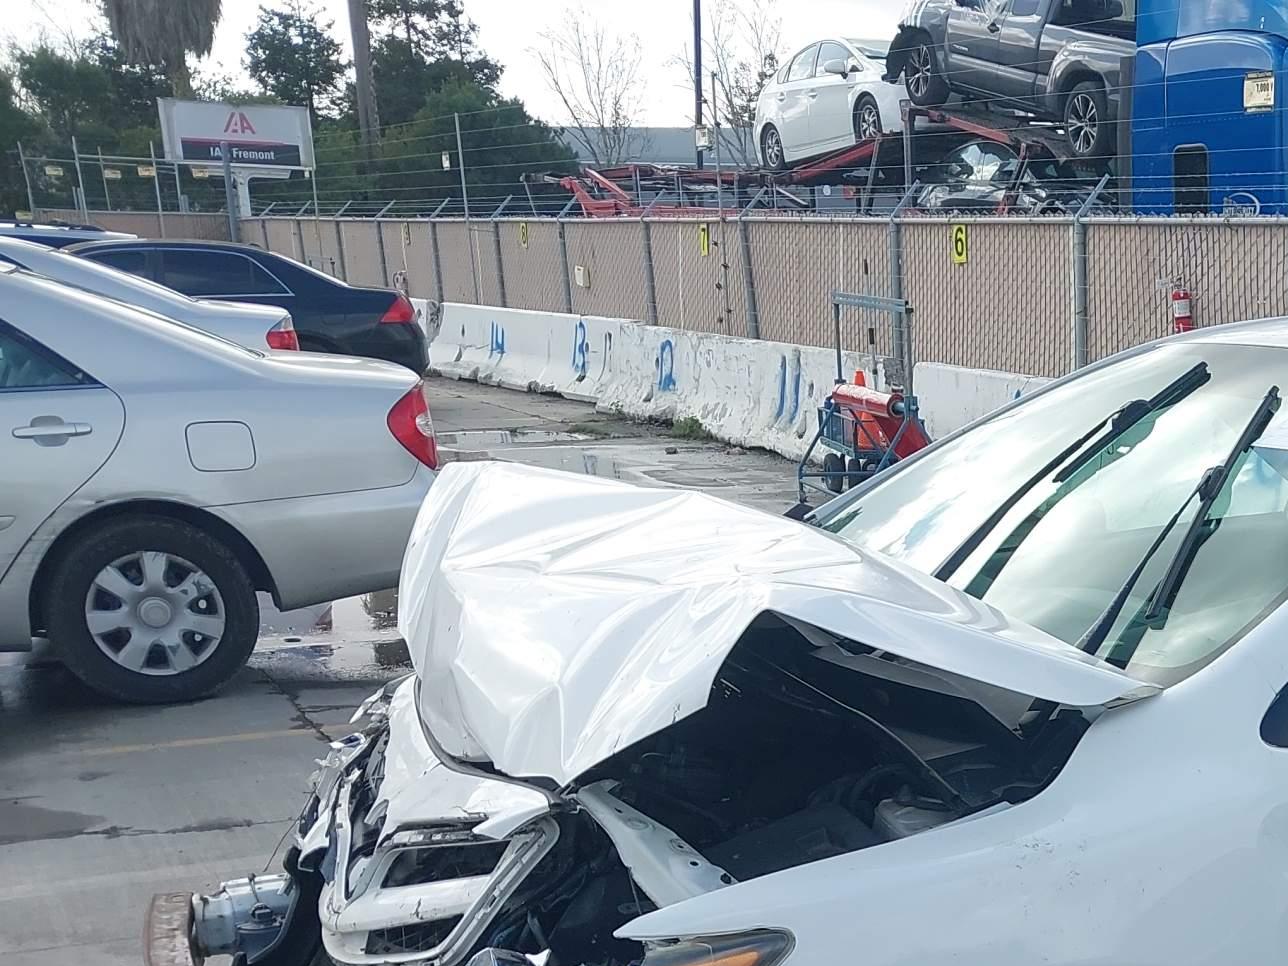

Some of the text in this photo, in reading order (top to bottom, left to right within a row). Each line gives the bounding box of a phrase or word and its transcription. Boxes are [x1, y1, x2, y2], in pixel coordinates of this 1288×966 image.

[210, 146, 275, 160] IA Fremont
[954, 226, 965, 257] 6
[488, 320, 506, 360] 14
